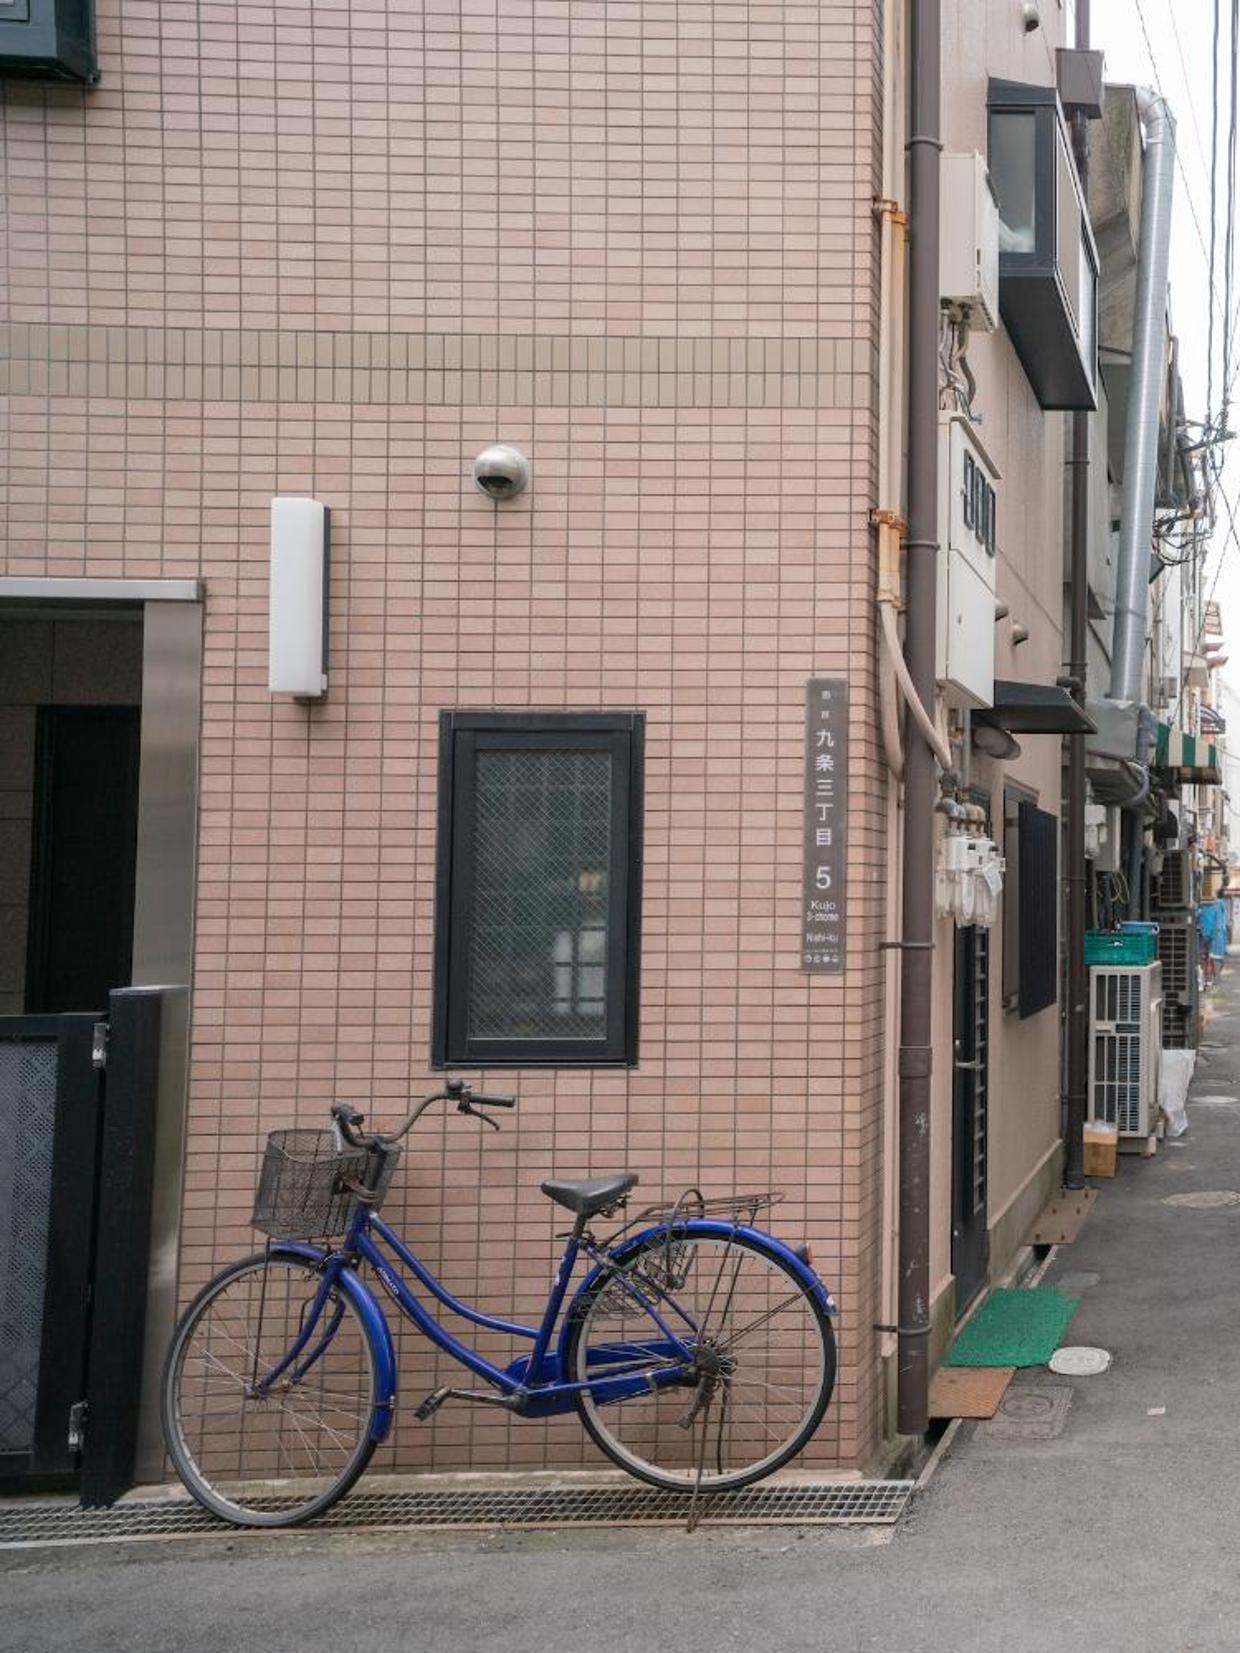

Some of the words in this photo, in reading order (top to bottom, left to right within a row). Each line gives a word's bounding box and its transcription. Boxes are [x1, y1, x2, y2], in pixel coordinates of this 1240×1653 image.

[815, 729, 834, 846] 九条三丁目
[815, 866, 832, 890] 5
[810, 899, 836, 911] Kujo
